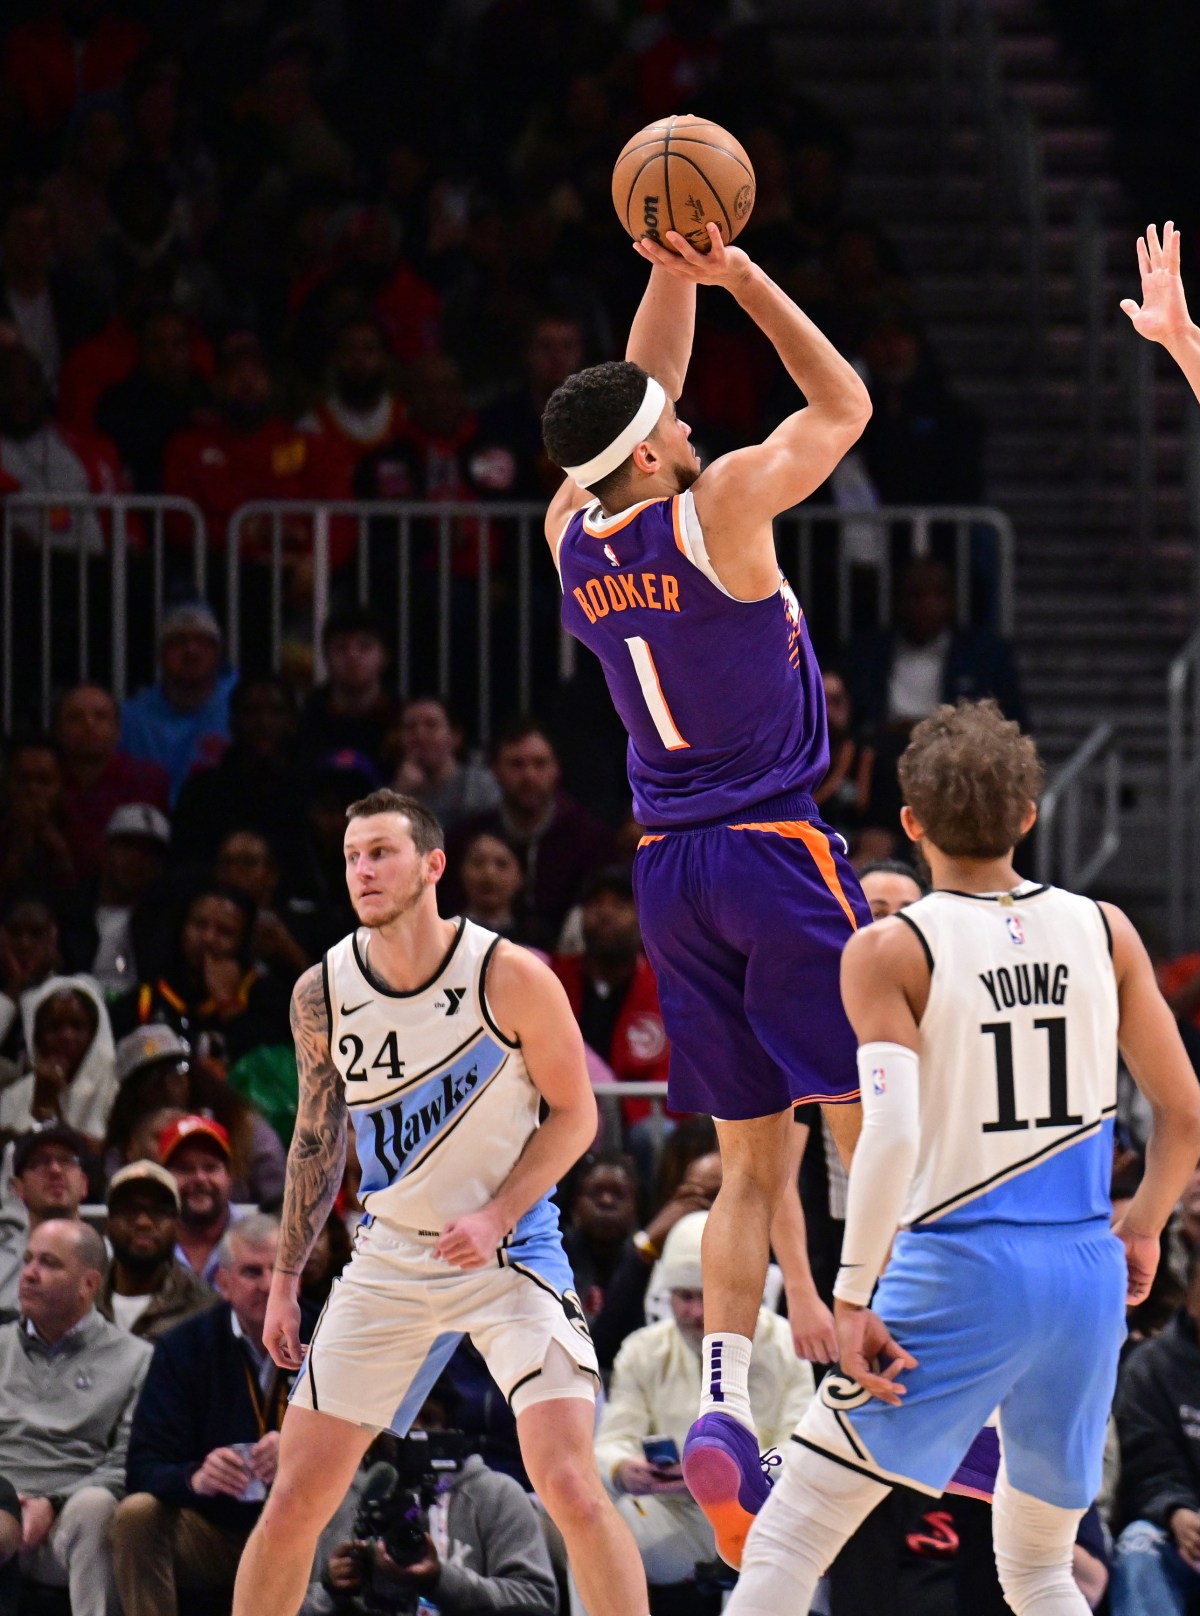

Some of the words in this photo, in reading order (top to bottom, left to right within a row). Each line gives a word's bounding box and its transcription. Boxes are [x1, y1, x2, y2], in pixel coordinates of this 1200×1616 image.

[641, 195, 661, 245] son
[572, 573, 681, 624] BOOKER
[623, 635, 691, 752] 1
[978, 962, 1069, 1012] YOUNG
[338, 1030, 406, 1082] 24
[980, 1016, 1084, 1133] 11
[366, 1063, 479, 1187] Hawks
